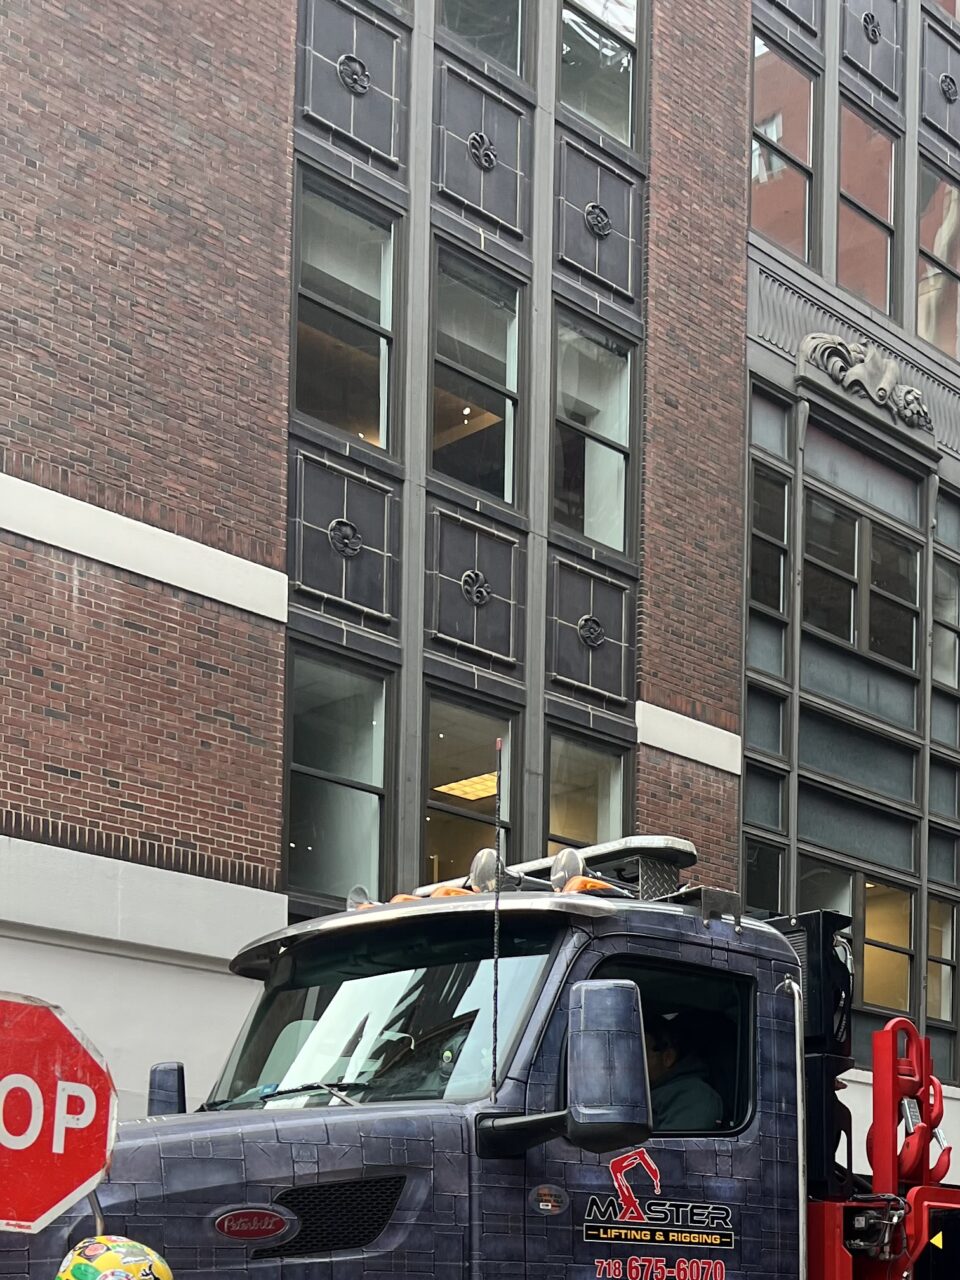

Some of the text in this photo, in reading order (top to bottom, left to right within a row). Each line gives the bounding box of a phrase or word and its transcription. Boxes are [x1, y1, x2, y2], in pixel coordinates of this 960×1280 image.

[584, 1195, 733, 1229] MASTER
[224, 1216, 280, 1233] Peterbilt
[599, 1228, 721, 1245] LIFTING & RIGGING
[595, 1259, 622, 1278] 718
